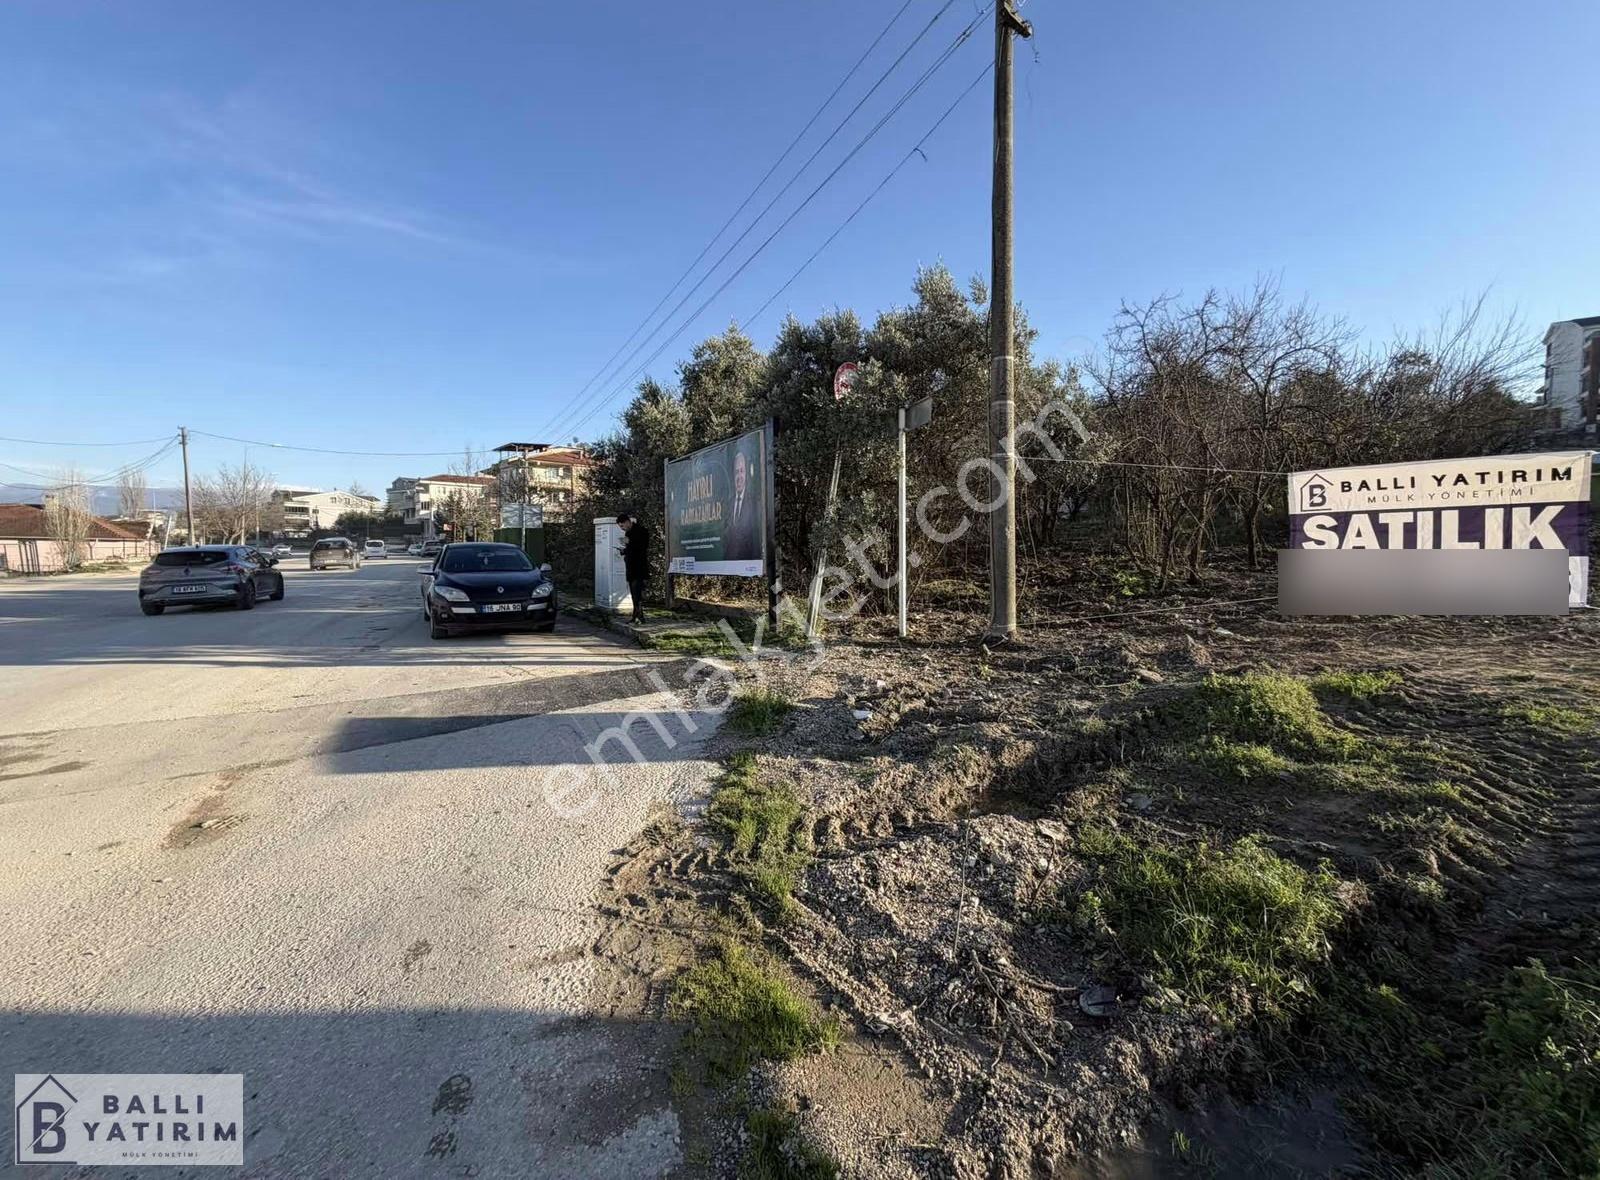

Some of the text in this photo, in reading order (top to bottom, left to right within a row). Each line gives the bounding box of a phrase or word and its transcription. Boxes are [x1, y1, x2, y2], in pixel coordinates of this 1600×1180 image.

[1341, 467, 1572, 493] BALLI YATIRIM
[1368, 493, 1415, 504] MÜLK
[1301, 505, 1566, 550] SATILIK
